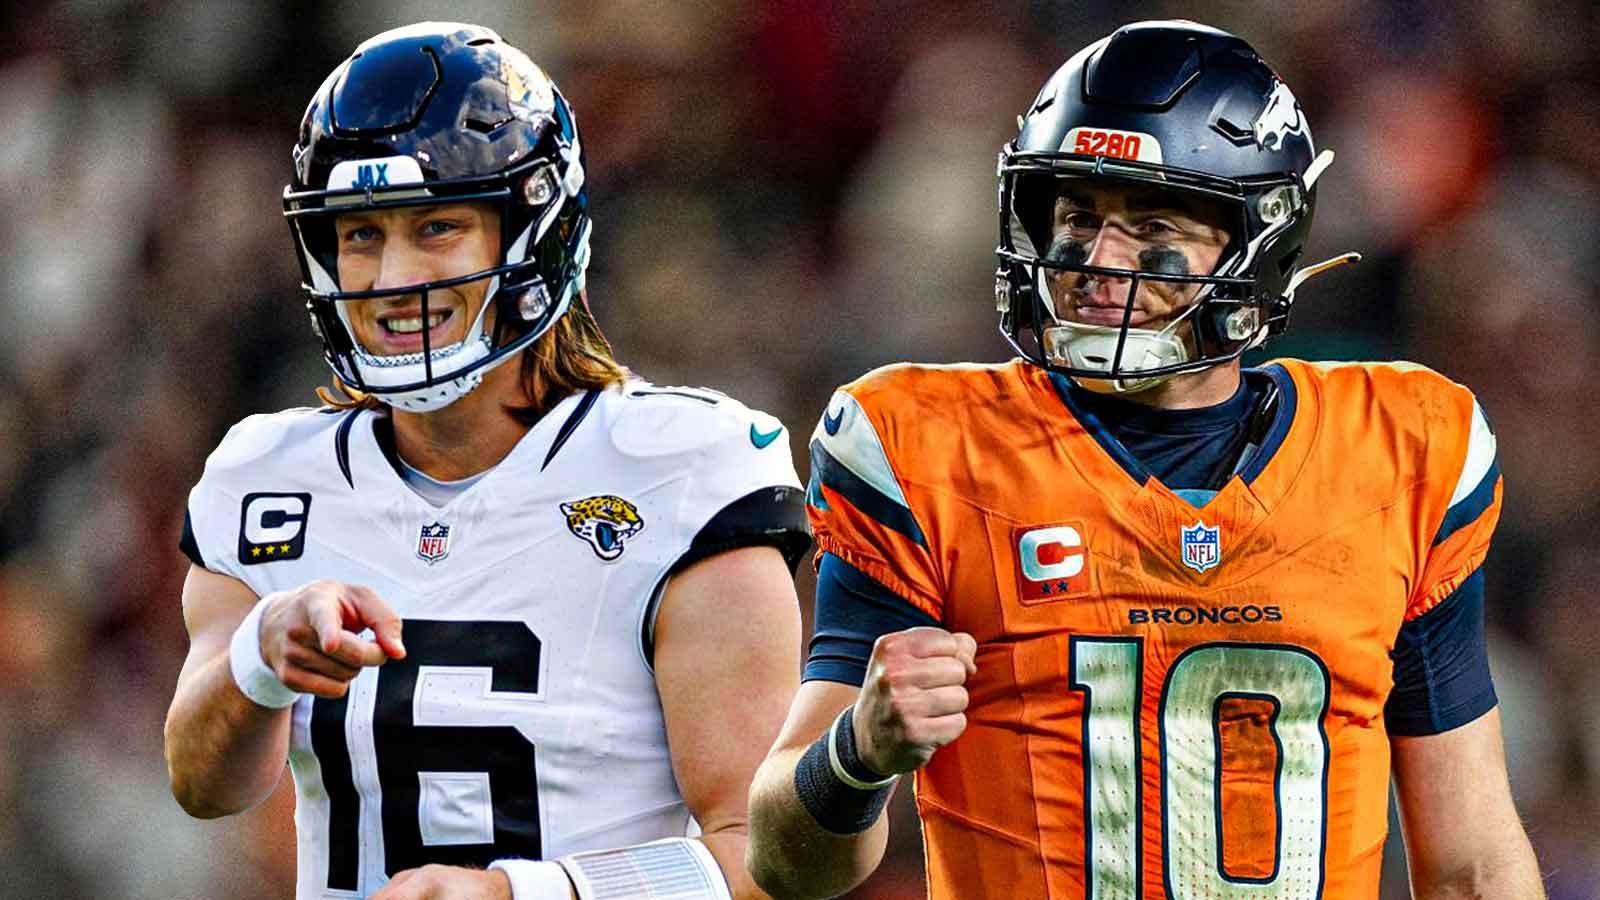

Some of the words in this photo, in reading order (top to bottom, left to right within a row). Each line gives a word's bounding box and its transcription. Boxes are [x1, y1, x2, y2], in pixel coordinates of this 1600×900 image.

[1074, 131, 1141, 160] 5280
[352, 163, 388, 189] JAX
[245, 497, 304, 544] C
[421, 538, 446, 555] NFL
[1019, 526, 1084, 581] C
[1188, 545, 1215, 563] NFL
[1128, 605, 1283, 625] BRONCOS
[310, 619, 542, 892] 16
[1069, 635, 1331, 900] 10
